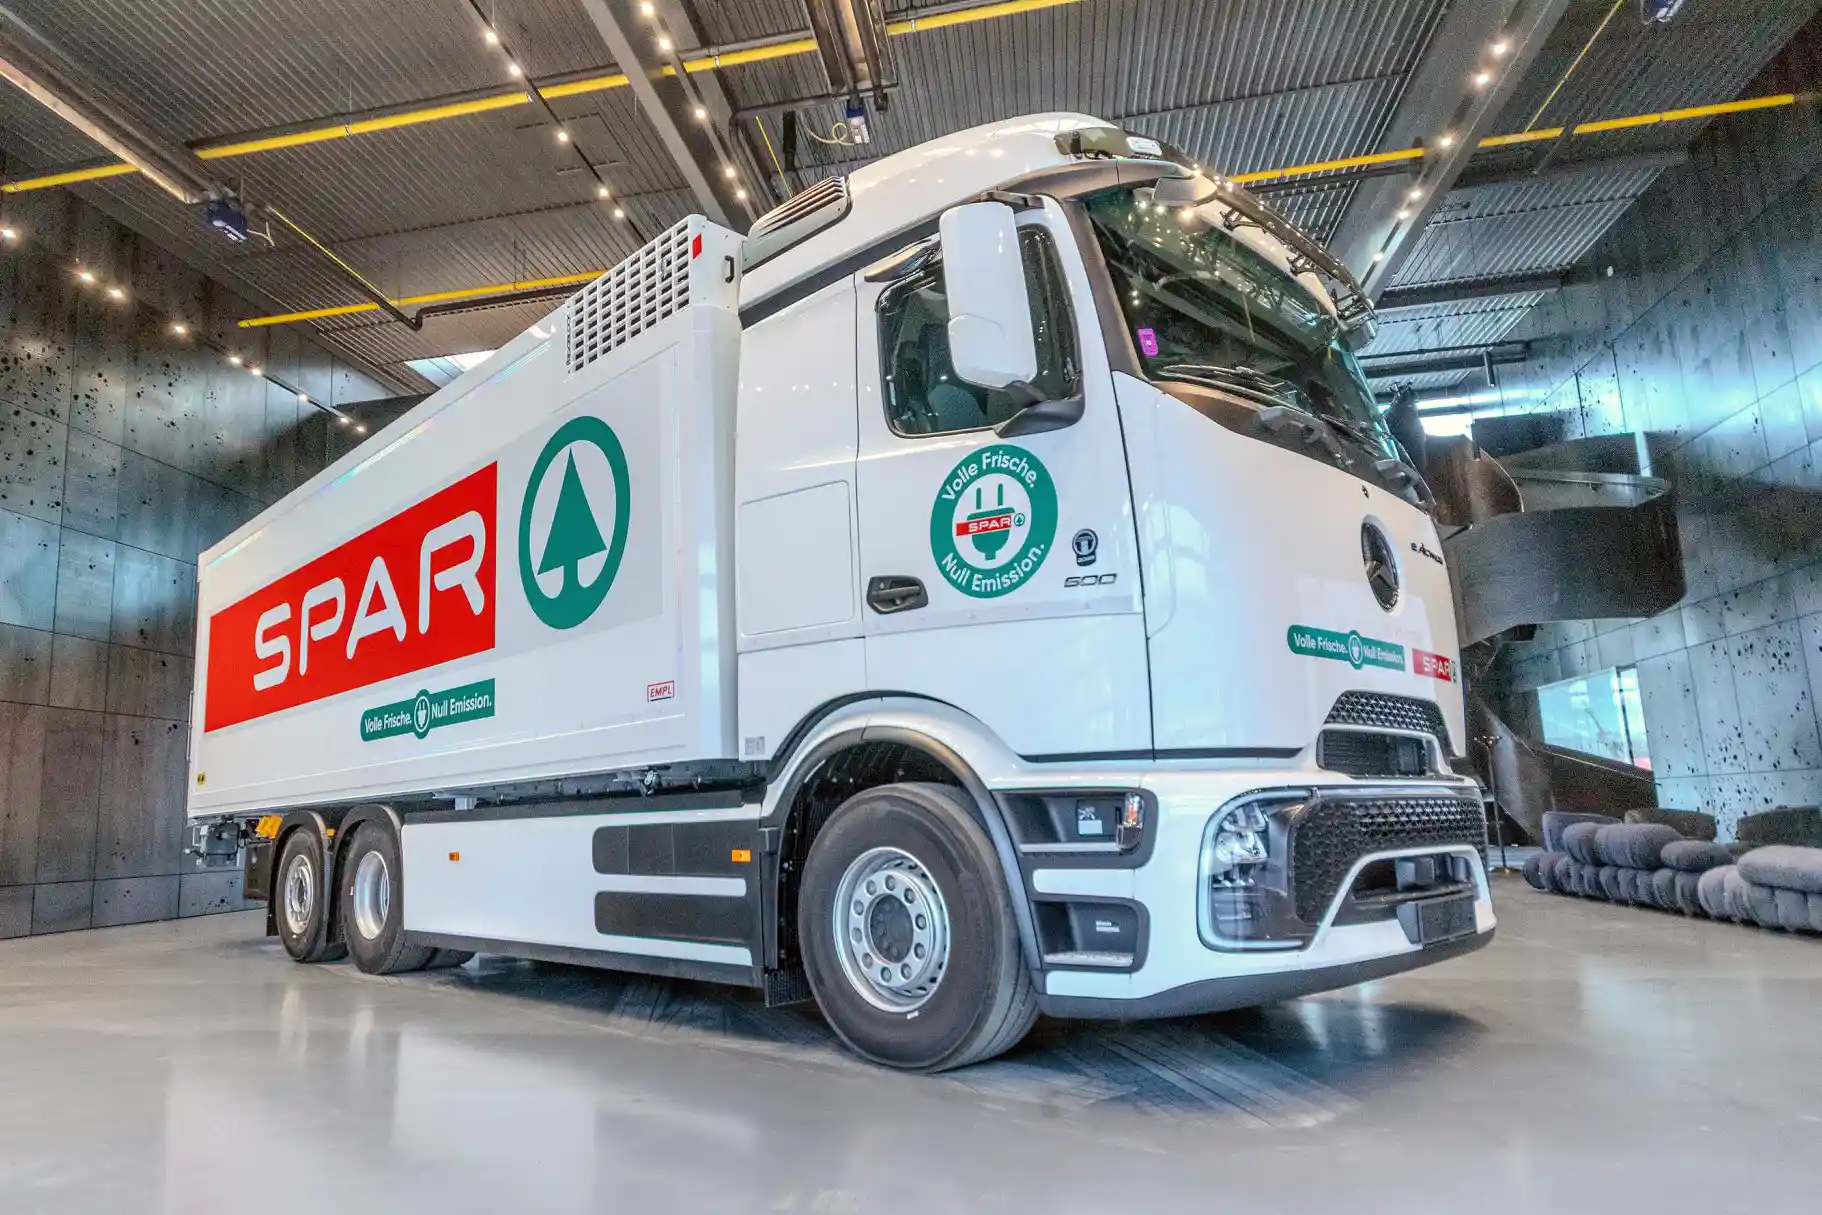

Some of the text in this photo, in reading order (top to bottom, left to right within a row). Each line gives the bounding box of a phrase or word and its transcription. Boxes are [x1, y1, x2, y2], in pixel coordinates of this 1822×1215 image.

[942, 450, 1037, 501] Volle Frische.
[968, 516, 1011, 533] SPAR
[941, 543, 1045, 592] Null Emission.
[1063, 573, 1117, 588] 600
[253, 510, 486, 691] SPAR
[1293, 632, 1316, 650] Volle
[1317, 636, 1348, 654] Frische.
[1422, 655, 1451, 678] SPAR
[650, 685, 673, 697] EMPL
[365, 692, 492, 733] Volle Frische. Null Emission.
